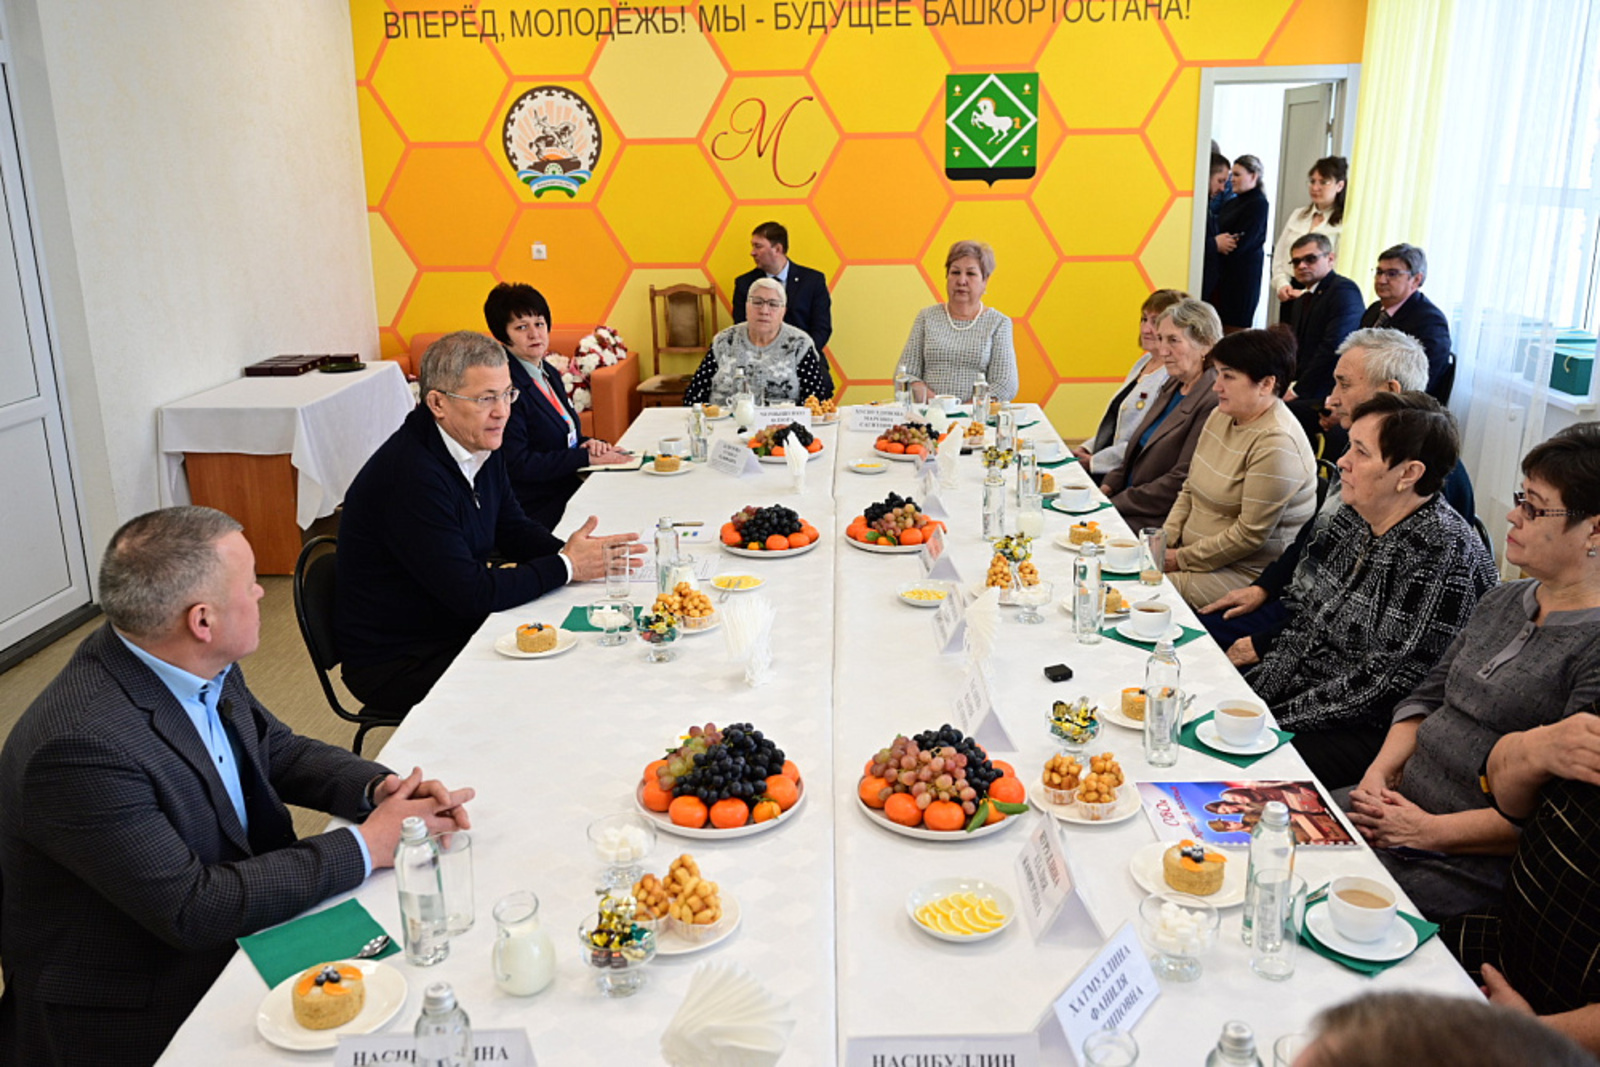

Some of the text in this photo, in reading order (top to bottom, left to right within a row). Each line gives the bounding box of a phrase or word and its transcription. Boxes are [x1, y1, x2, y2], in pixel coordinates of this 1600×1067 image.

[383, 4, 505, 43] ВПЕРЁД,
[510, 2, 686, 41] МОЛОДЁЖЬ!
[699, 4, 746, 32] МЫ
[774, 0, 912, 35] БУДУЩЕЕ
[924, 0, 1190, 26] БАШКОРТОСТАНА!
[1068, 944, 1131, 1018] ХАТМУЛЛИНА
[1090, 972, 1129, 1021] ФАНИЛЯ
[872, 1054, 1016, 1067] НАСИБУЛЛИН
